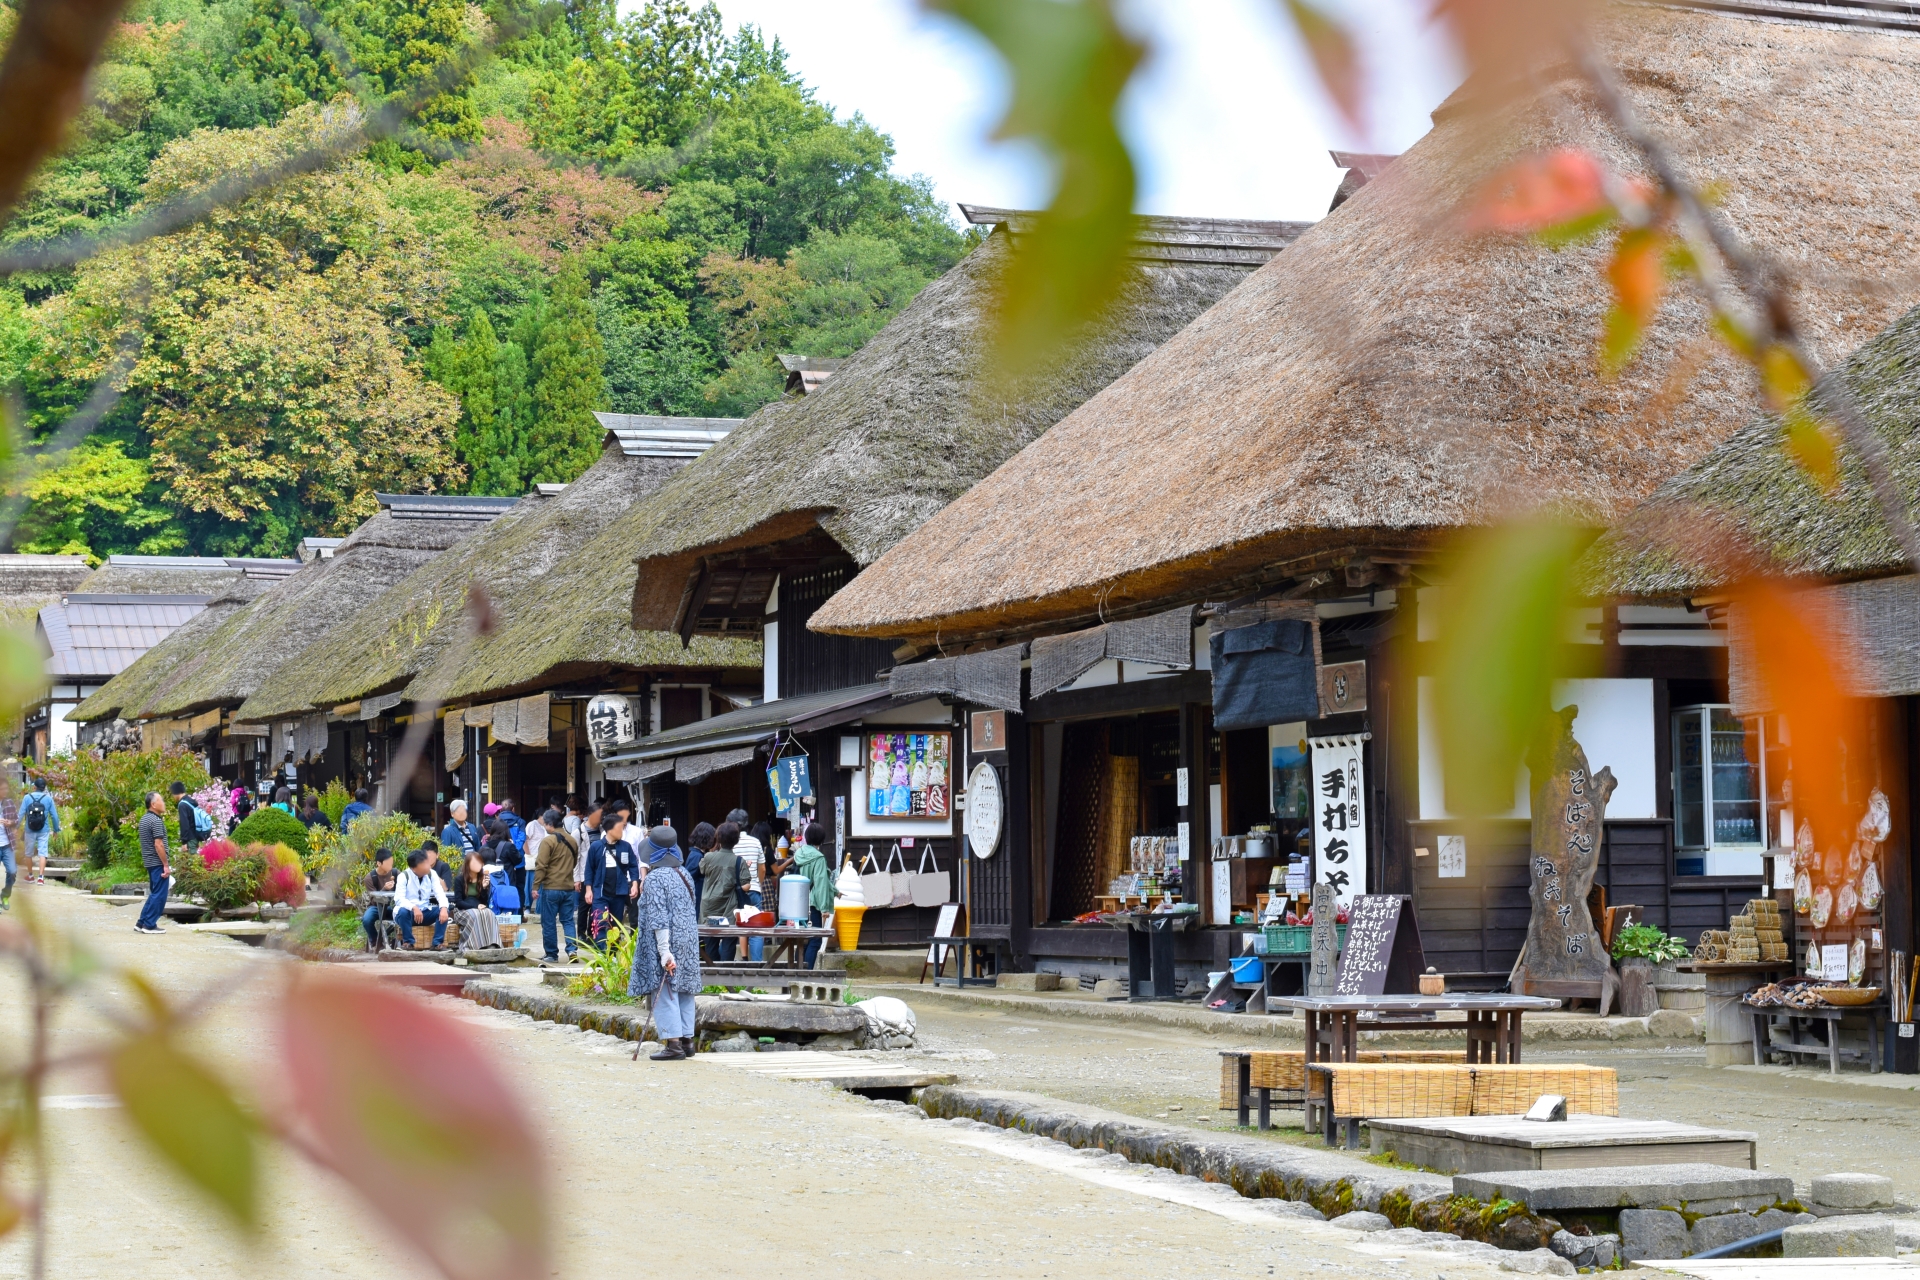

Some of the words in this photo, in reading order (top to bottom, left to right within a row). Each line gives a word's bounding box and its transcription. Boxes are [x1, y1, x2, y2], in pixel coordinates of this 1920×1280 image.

[621, 703, 633, 737] そば
[896, 738, 904, 756] 巨峰
[916, 736, 924, 756] バニラ
[934, 738, 941, 757] そば
[788, 761, 802, 794] ところてん
[1350, 764, 1358, 821] 大内宿
[1566, 768, 1592, 854] そば処
[1321, 768, 1350, 909] 手打ちそ
[1353, 908, 1399, 919] ねぎ一本そば
[1535, 856, 1587, 954] ねぎそば
[1351, 920, 1385, 930] 山菜そば
[1316, 890, 1331, 986] 営業中
[1350, 930, 1391, 941] きのこそば
[1346, 948, 1379, 961] ざるそば
[1347, 940, 1381, 951] 岩魚そば
[1344, 959, 1387, 972] そばぜんざい
[1340, 970, 1363, 981] うどん
[1336, 982, 1359, 995] 天ぷら
